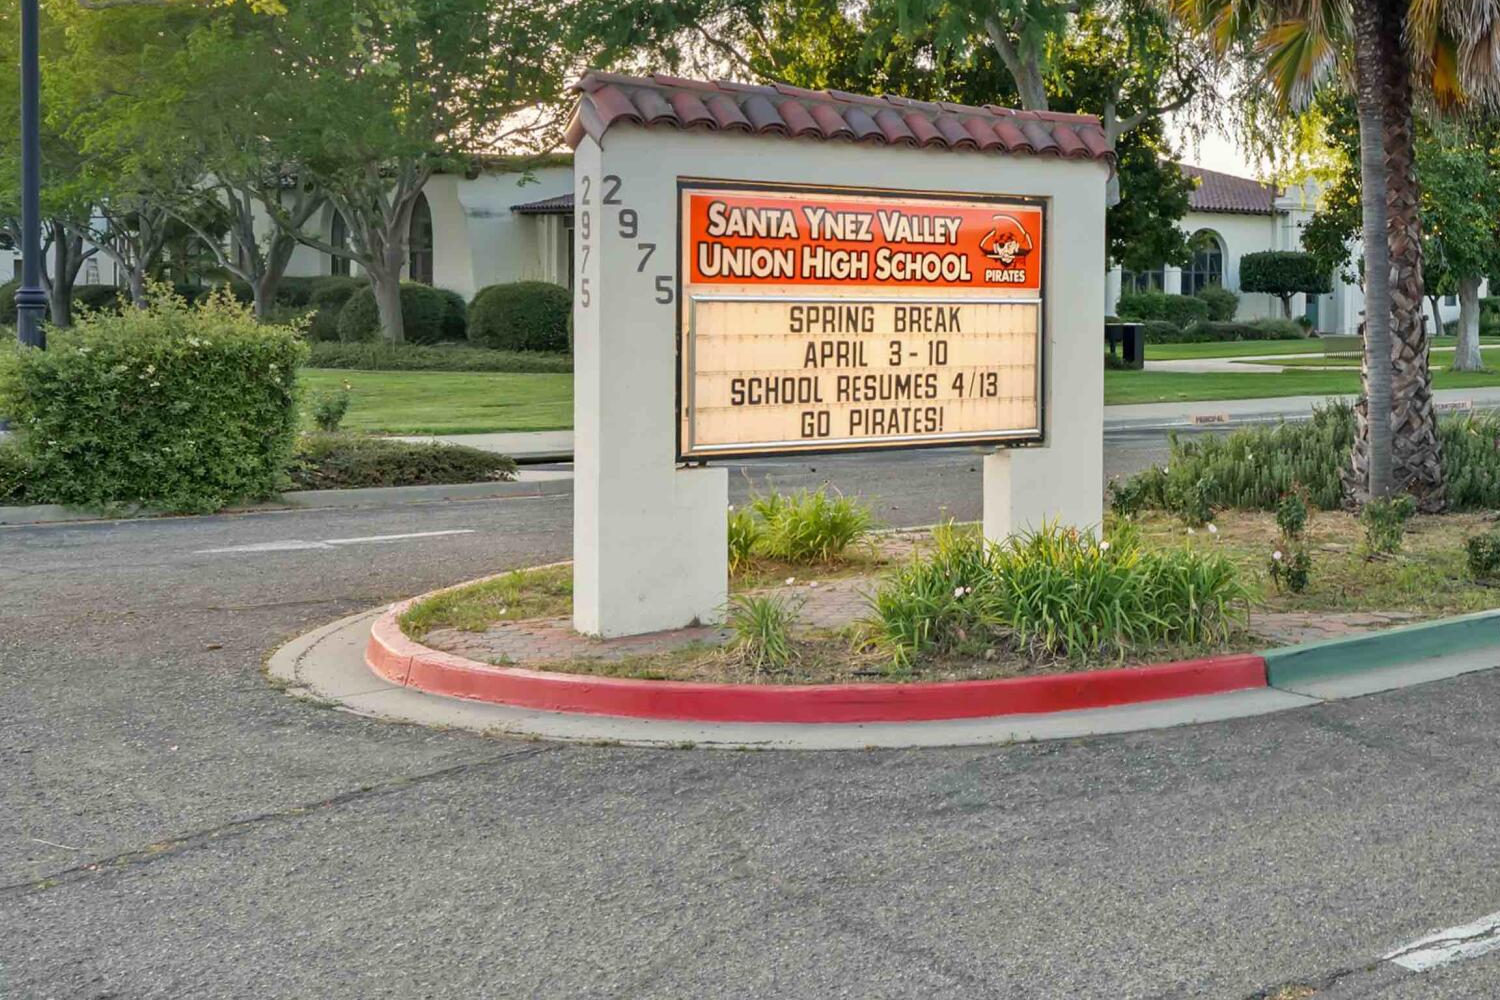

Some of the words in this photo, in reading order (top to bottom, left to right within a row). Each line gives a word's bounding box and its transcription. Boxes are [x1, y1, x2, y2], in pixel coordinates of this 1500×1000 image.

[602, 174, 674, 305] 2975
[707, 200, 799, 239] SANTA
[802, 206, 874, 242] YNEZ
[877, 209, 963, 245] VALLEY
[581, 175, 591, 308] 2975
[698, 242, 795, 278] UNION
[801, 246, 870, 281] HIGH
[874, 247, 972, 283] SCHOOL
[984, 268, 1026, 283] PIRATES
[789, 305, 875, 333] SPRING
[894, 306, 961, 333] BREAK
[803, 340, 868, 369] APRIL
[730, 376, 824, 406] SCHOOL
[837, 373, 938, 402] RESUMES
[951, 371, 998, 399] 4/13
[801, 410, 831, 438] GO
[849, 406, 944, 436] PIRATES!
